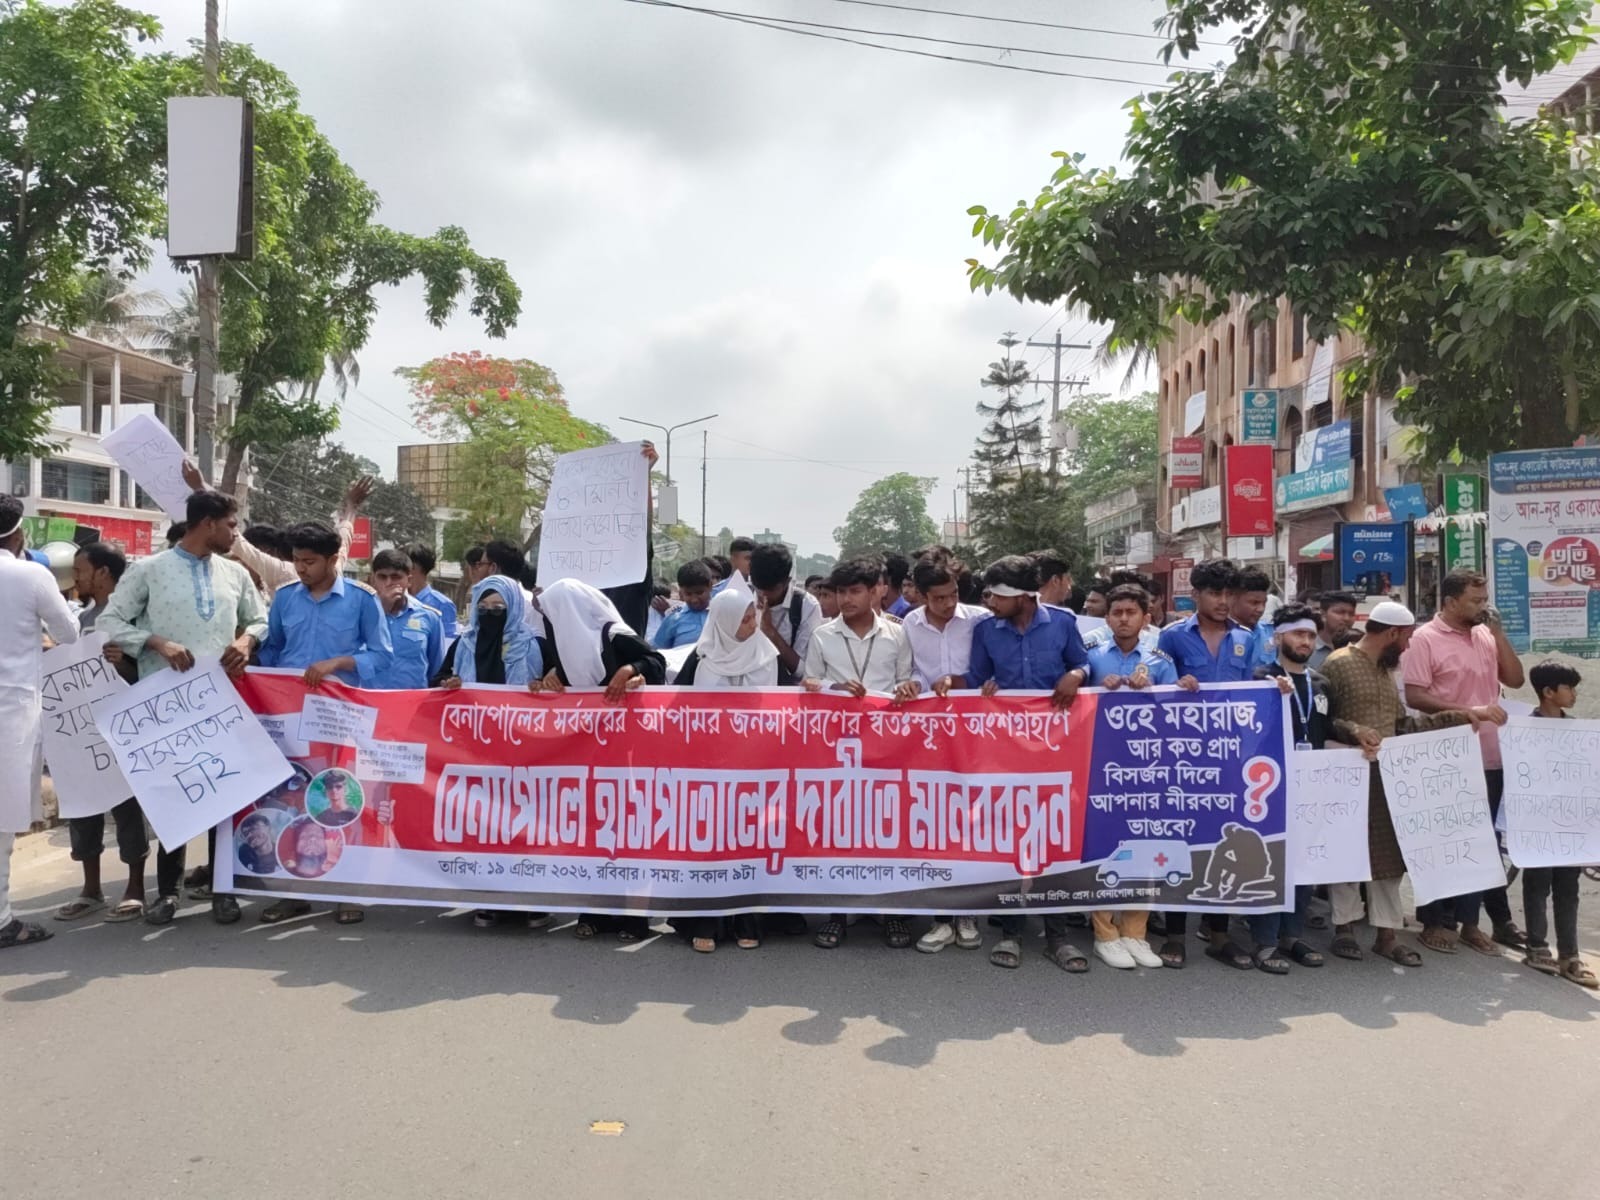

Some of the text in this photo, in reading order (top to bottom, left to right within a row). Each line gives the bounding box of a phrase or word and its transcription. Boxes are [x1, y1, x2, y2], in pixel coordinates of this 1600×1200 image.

[1551, 538, 1588, 563] ভর্তি
[1543, 563, 1596, 582] চলছে
[441, 702, 545, 745] বেনাপোলের
[552, 698, 628, 746] সর্বস্তরের
[633, 706, 723, 745] আপামর
[729, 704, 863, 747] জনসাধারণের
[961, 707, 1072, 751] অংশগ্রহণে
[1104, 698, 1264, 734] ওহে মহারাজ,
[1126, 734, 1242, 761] আর কত প্রাণ
[1103, 759, 1222, 788] বিসর্জন দিলে
[433, 736, 1073, 876] বেনাপোলে হাসপাতালের দাবীতে মানববন্ধন
[1089, 785, 1238, 814] আপনার নীরবতা
[1126, 817, 1197, 838] ভাঙবে?
[438, 858, 483, 877] তারিখ:
[487, 861, 505, 877] ১৯
[510, 858, 547, 878] এপ্রিল
[552, 863, 592, 881] ২০২৬,
[650, 866, 685, 883] সময়:
[689, 866, 729, 884] সকাল
[732, 861, 756, 882] ৯টা
[792, 864, 824, 881] স্থান:
[829, 862, 895, 882] বেনাপোল
[899, 861, 954, 882] বলফিল্ড
